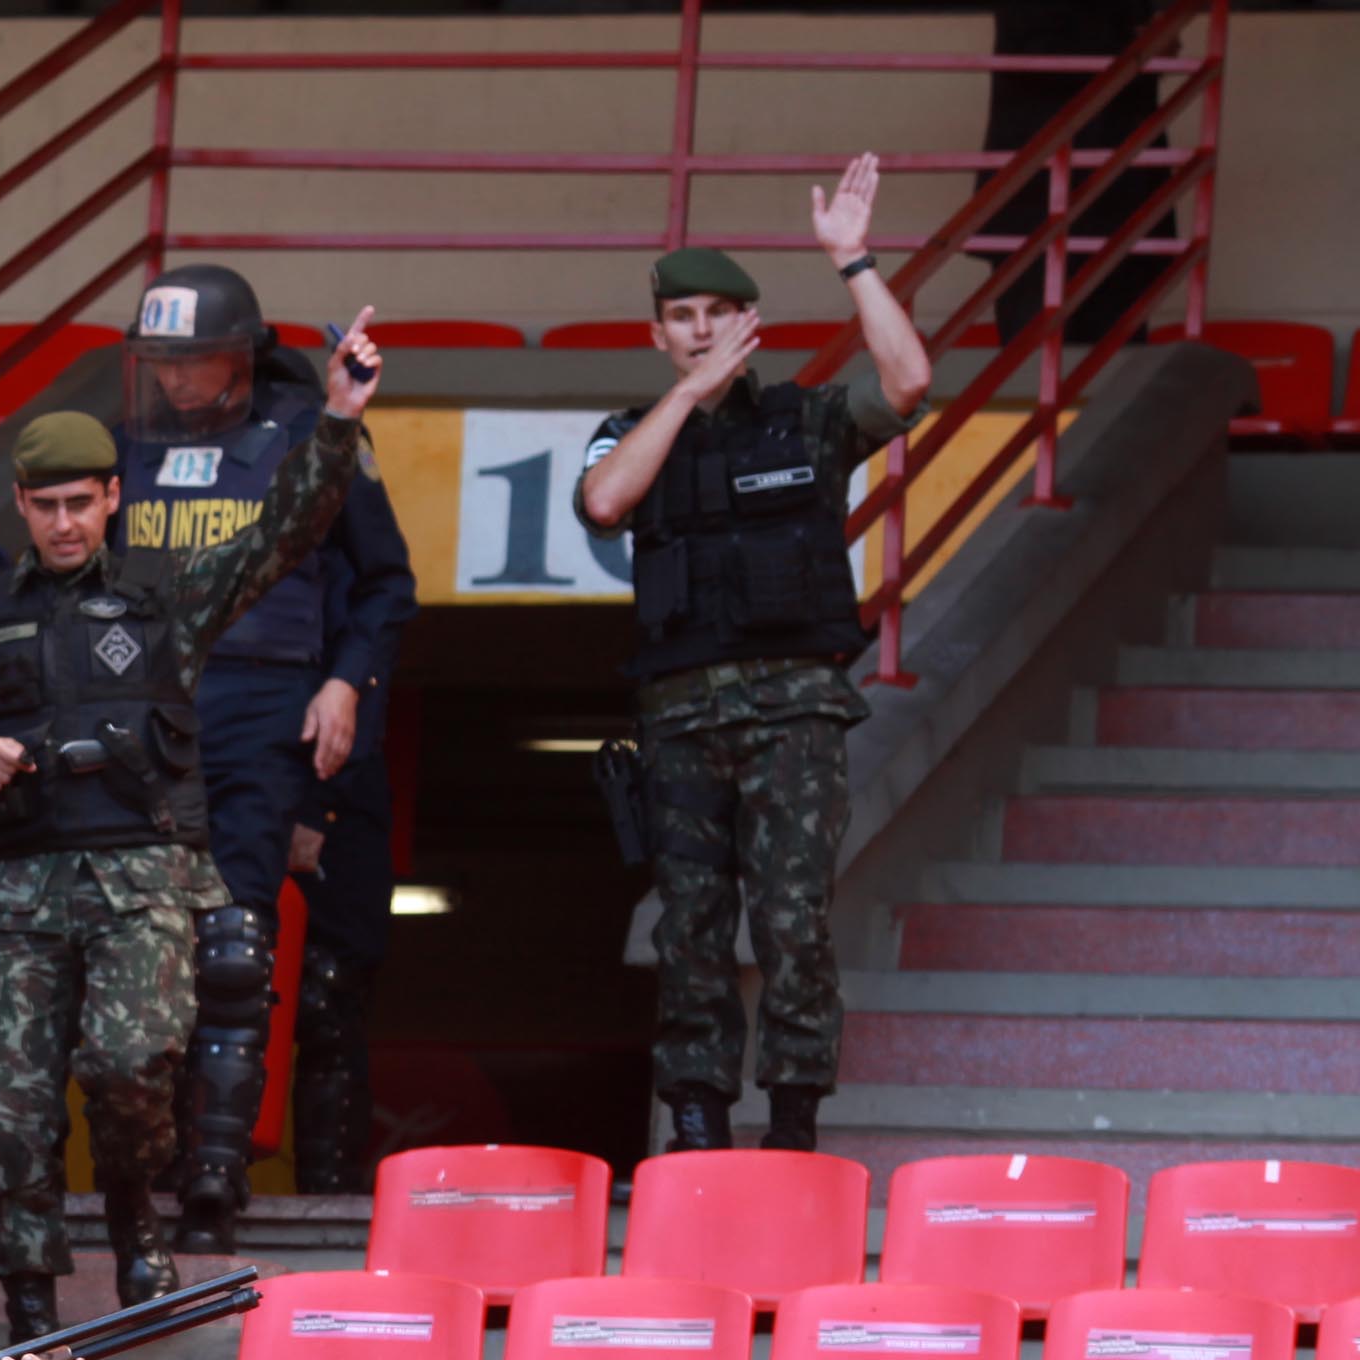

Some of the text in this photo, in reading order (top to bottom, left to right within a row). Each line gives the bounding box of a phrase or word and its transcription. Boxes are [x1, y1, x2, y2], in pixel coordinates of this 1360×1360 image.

[145, 299, 182, 332] 01
[172, 452, 216, 483] 01
[169, 499, 263, 550] INTERN
